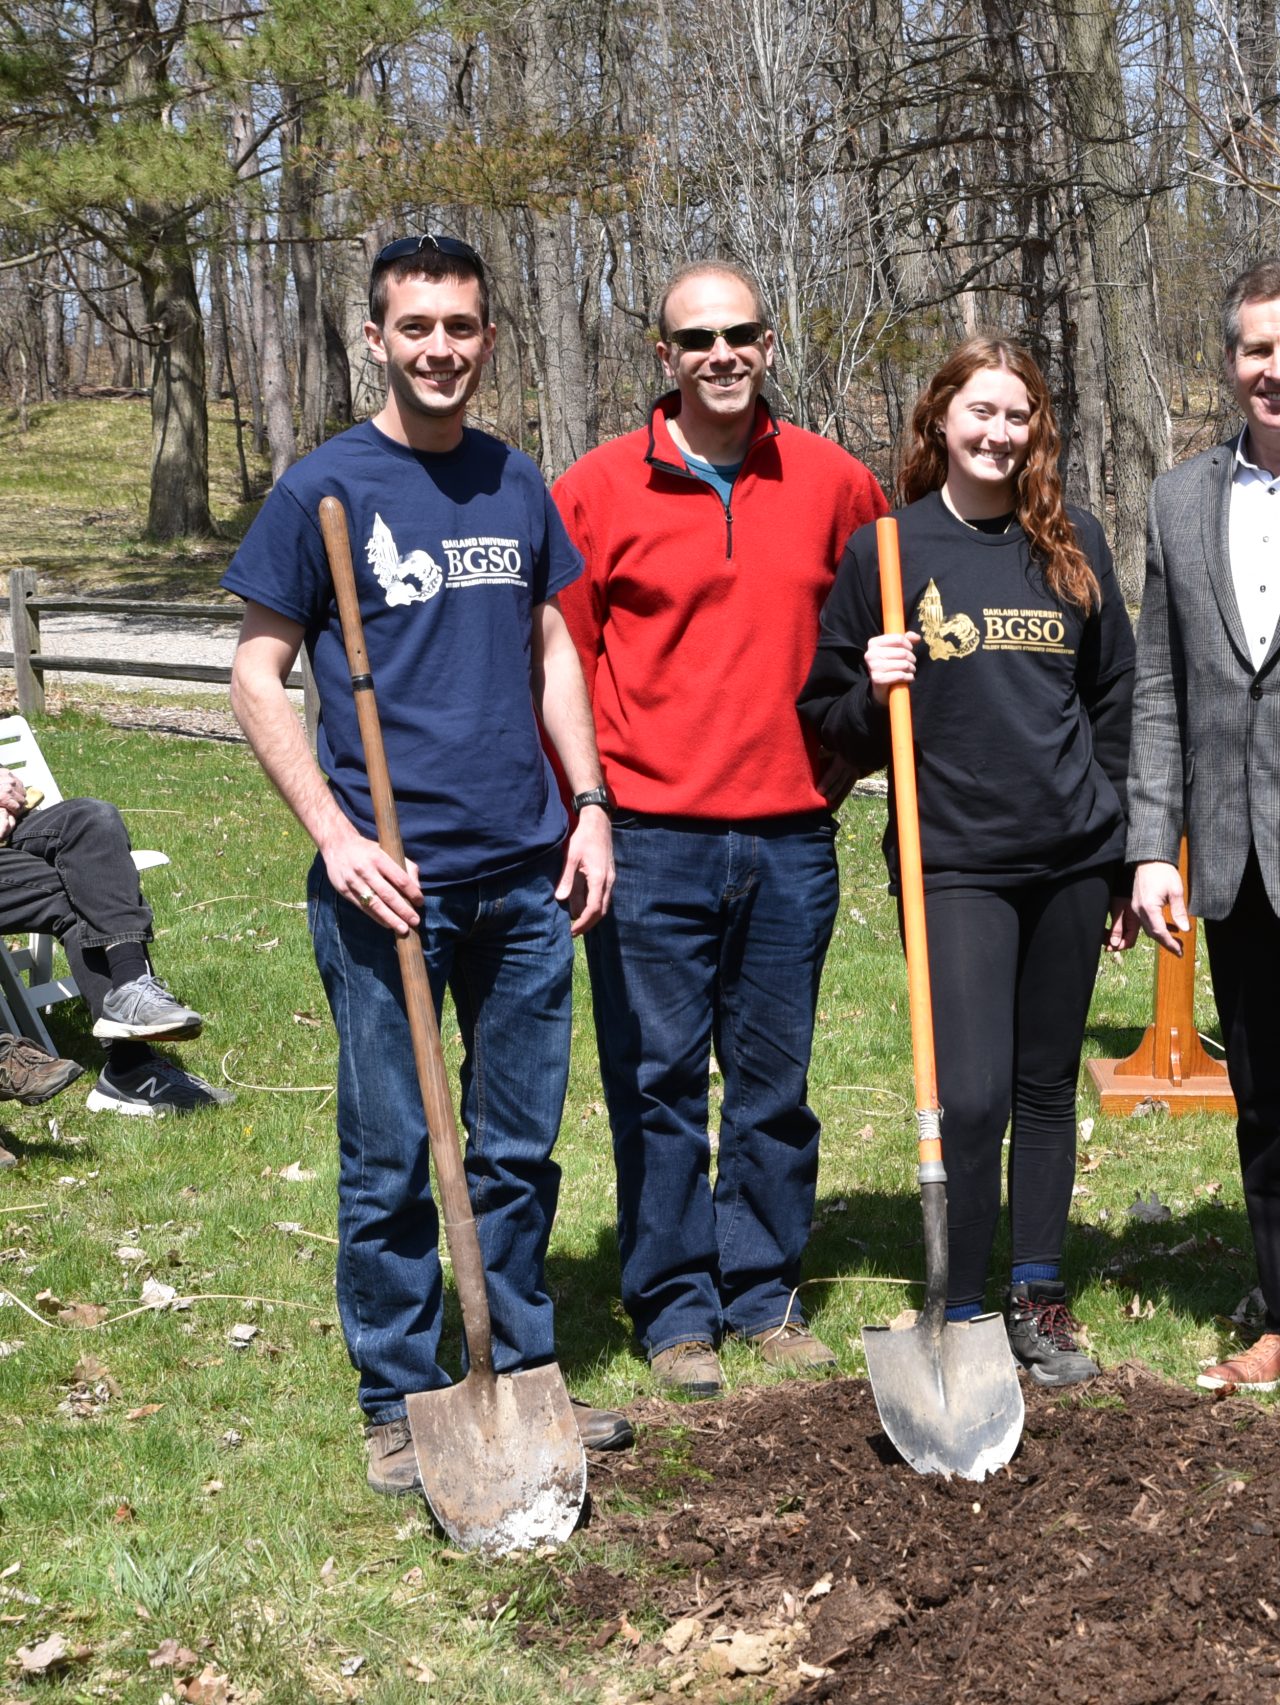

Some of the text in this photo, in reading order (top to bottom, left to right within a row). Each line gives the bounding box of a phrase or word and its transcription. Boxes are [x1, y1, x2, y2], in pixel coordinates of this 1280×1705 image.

[478, 536, 519, 549] UNIVERSITY
[444, 546, 521, 576] BGSO
[983, 608, 1062, 620] OAKLAND UNIVERSITY
[984, 616, 1065, 643] BGSO
